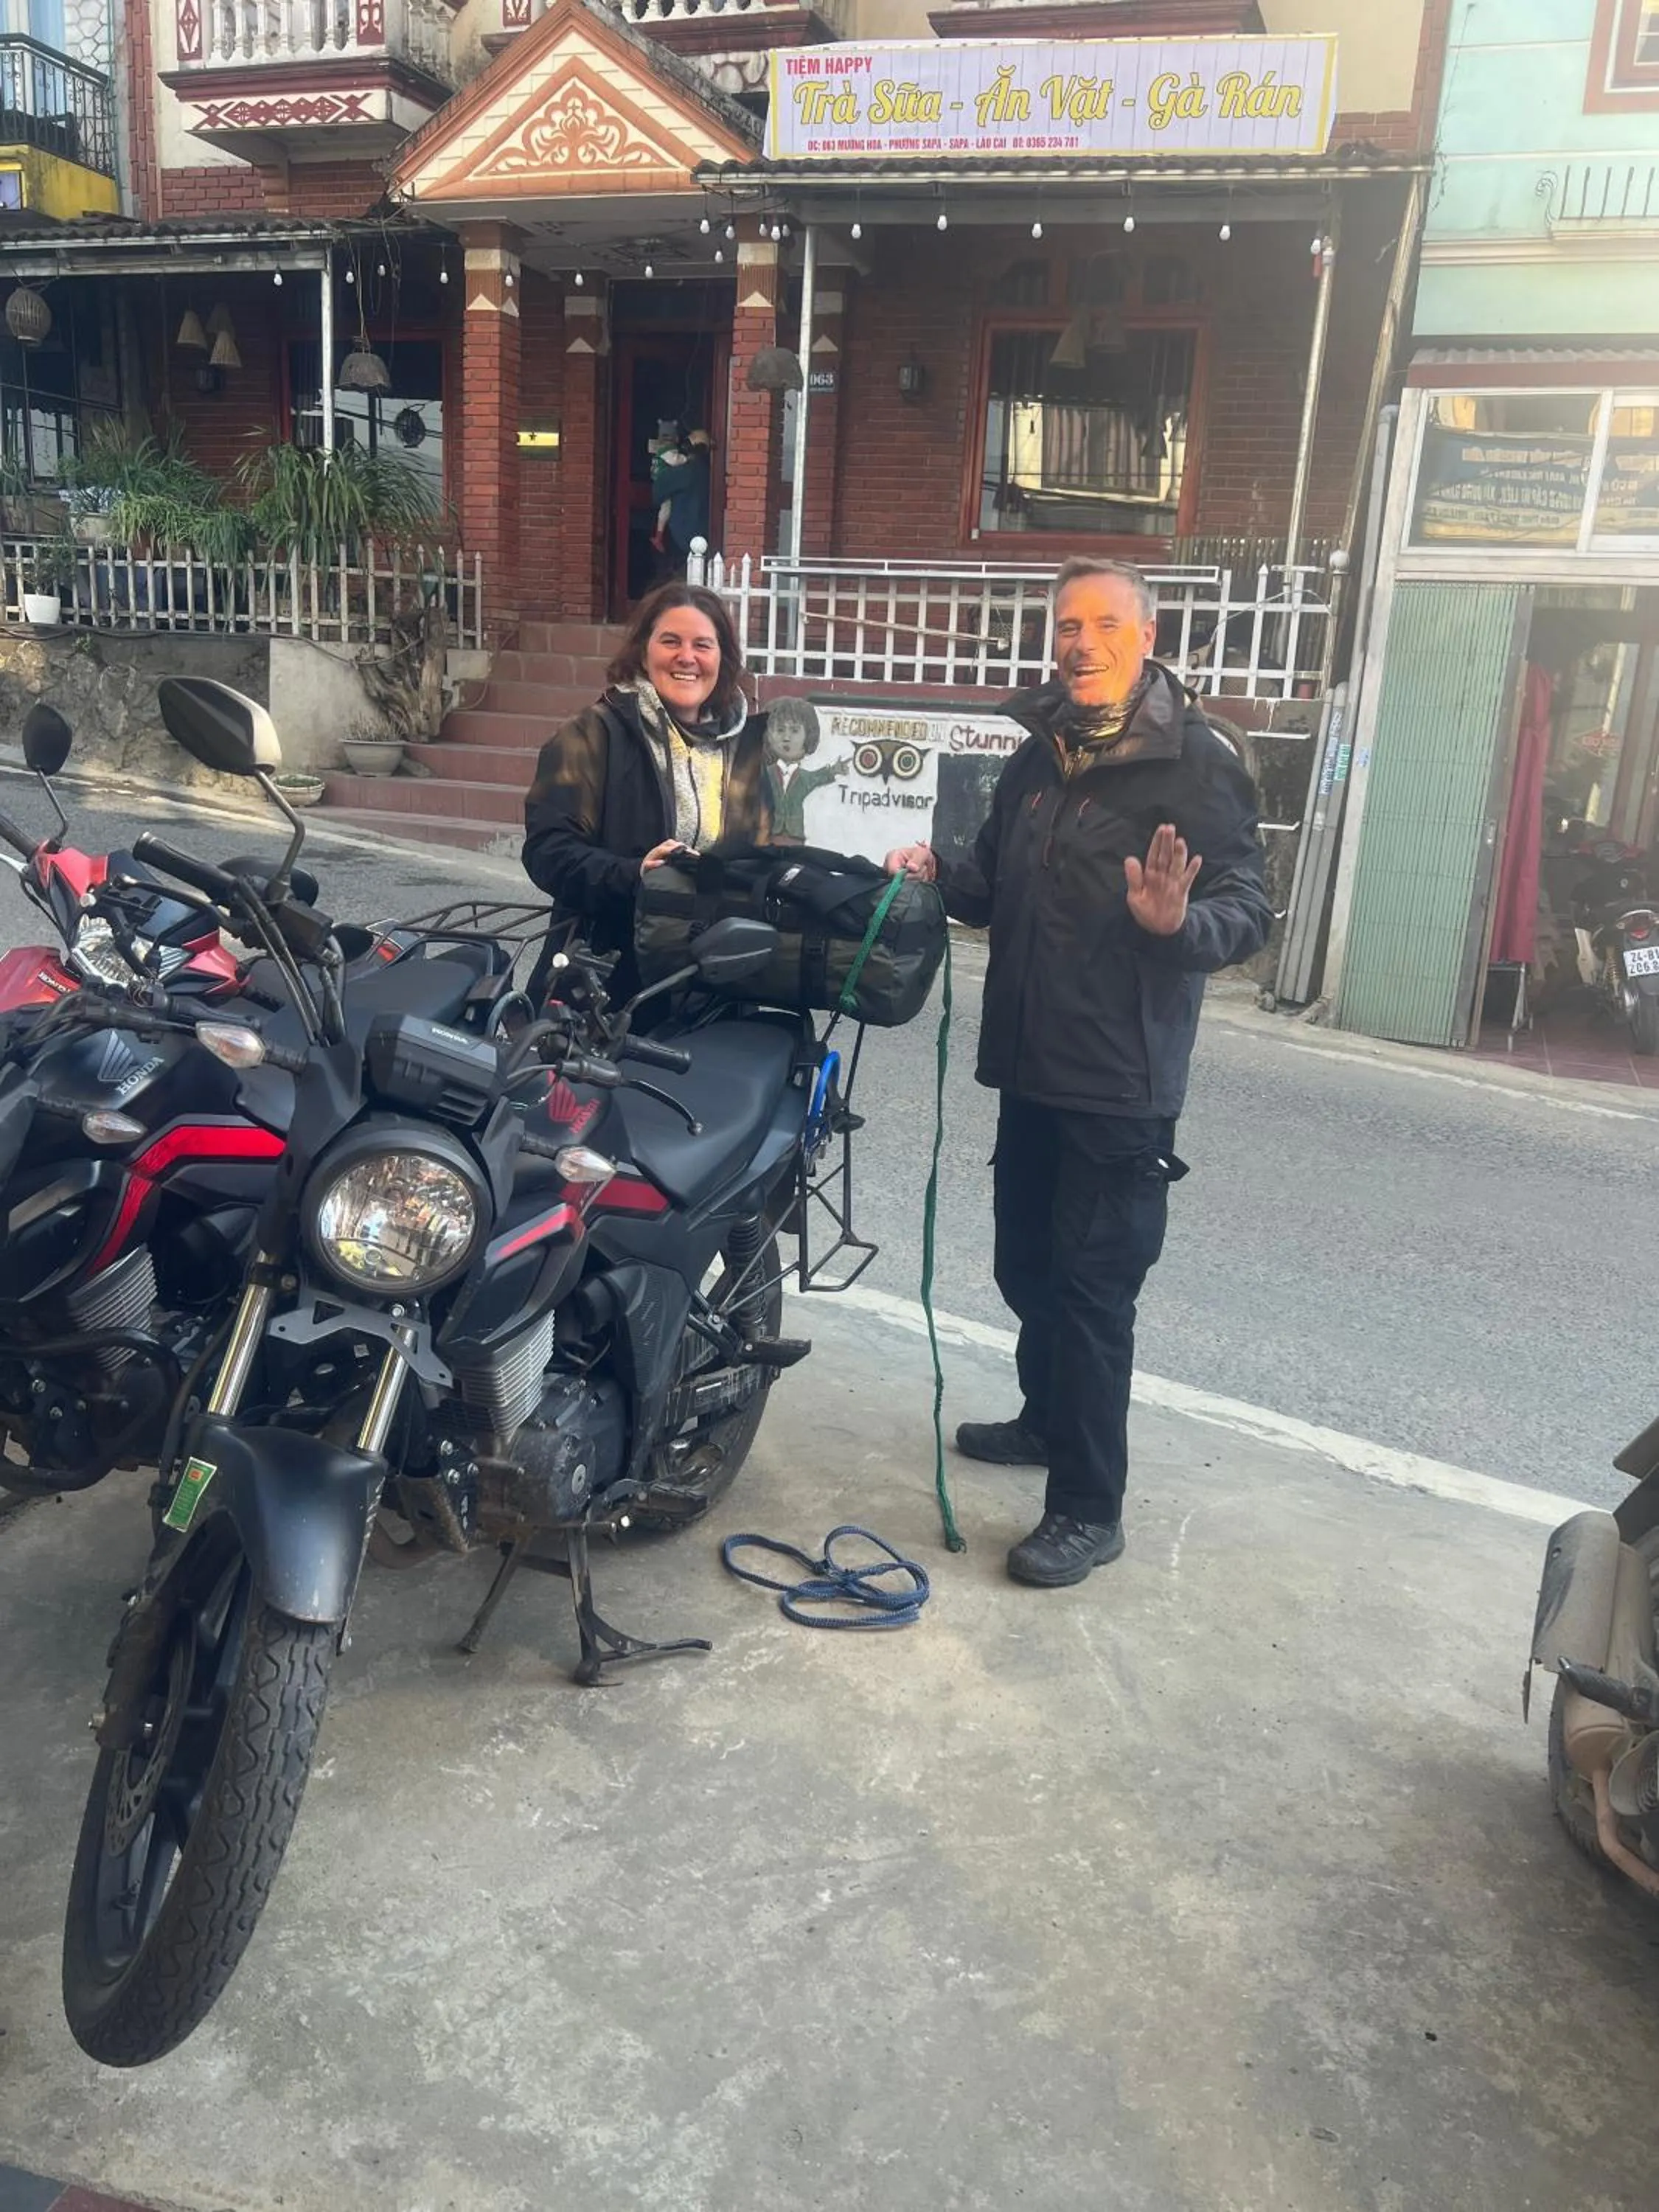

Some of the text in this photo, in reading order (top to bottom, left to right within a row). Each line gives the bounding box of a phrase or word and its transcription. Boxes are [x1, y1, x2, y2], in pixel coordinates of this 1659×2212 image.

[786, 56, 873, 78] TIỆM HAPPY
[793, 80, 861, 125] Trà
[869, 79, 943, 124] Sữa
[975, 64, 1031, 128] Ăn
[1039, 74, 1114, 127] Vặt
[1147, 72, 1208, 131] Gà
[1217, 71, 1302, 119] Rán
[838, 784, 934, 812] Tripadvisor
[114, 1057, 165, 1096] HONDA
